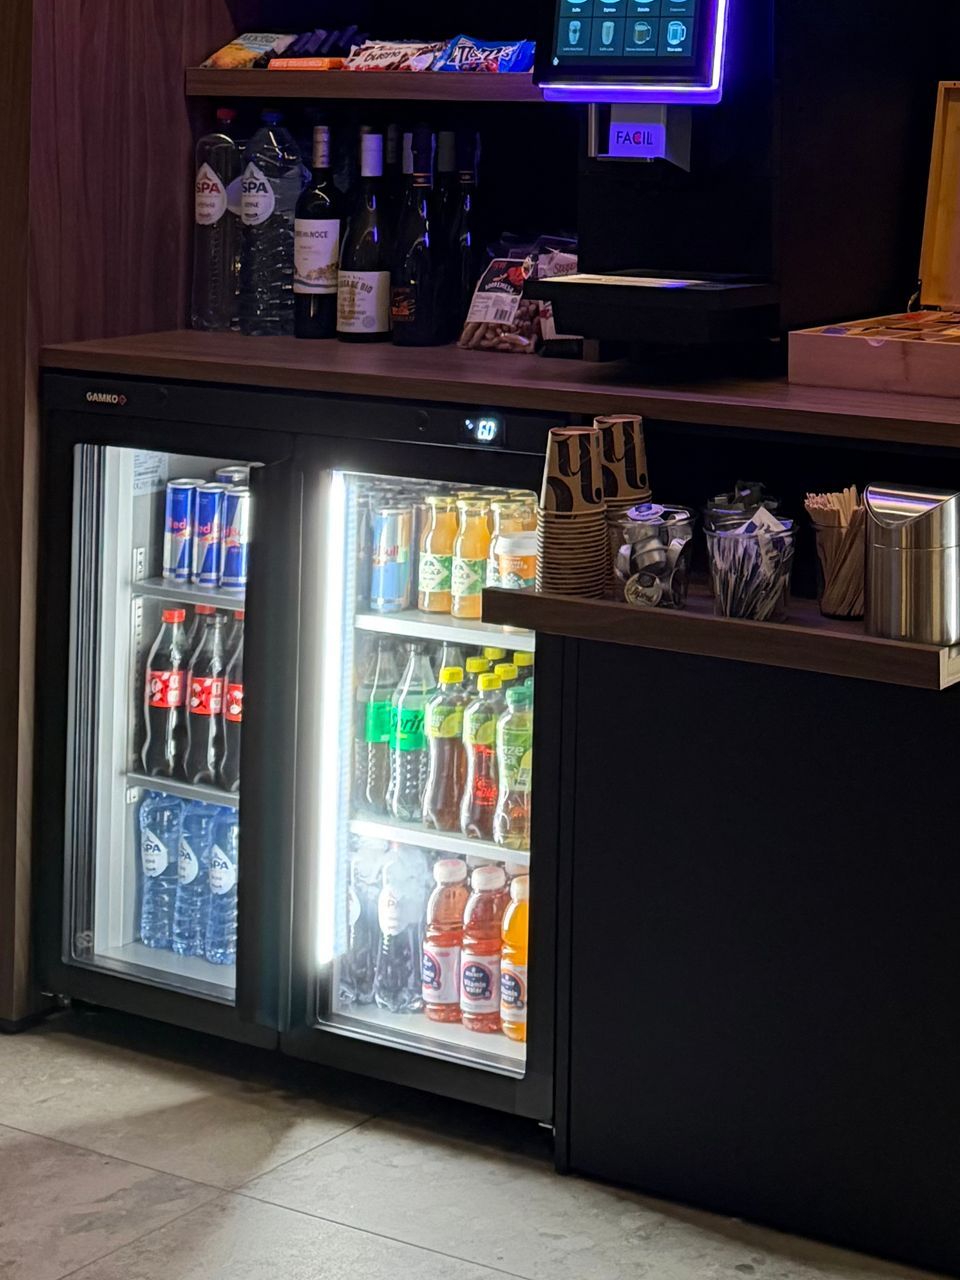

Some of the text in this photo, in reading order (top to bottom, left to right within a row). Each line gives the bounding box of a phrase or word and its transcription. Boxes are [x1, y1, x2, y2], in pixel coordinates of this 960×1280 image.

[616, 131, 653, 145] FACIL
[241, 182, 268, 194] SPA
[86, 392, 118, 403] GAMKO
[391, 712, 424, 735] Sprit
